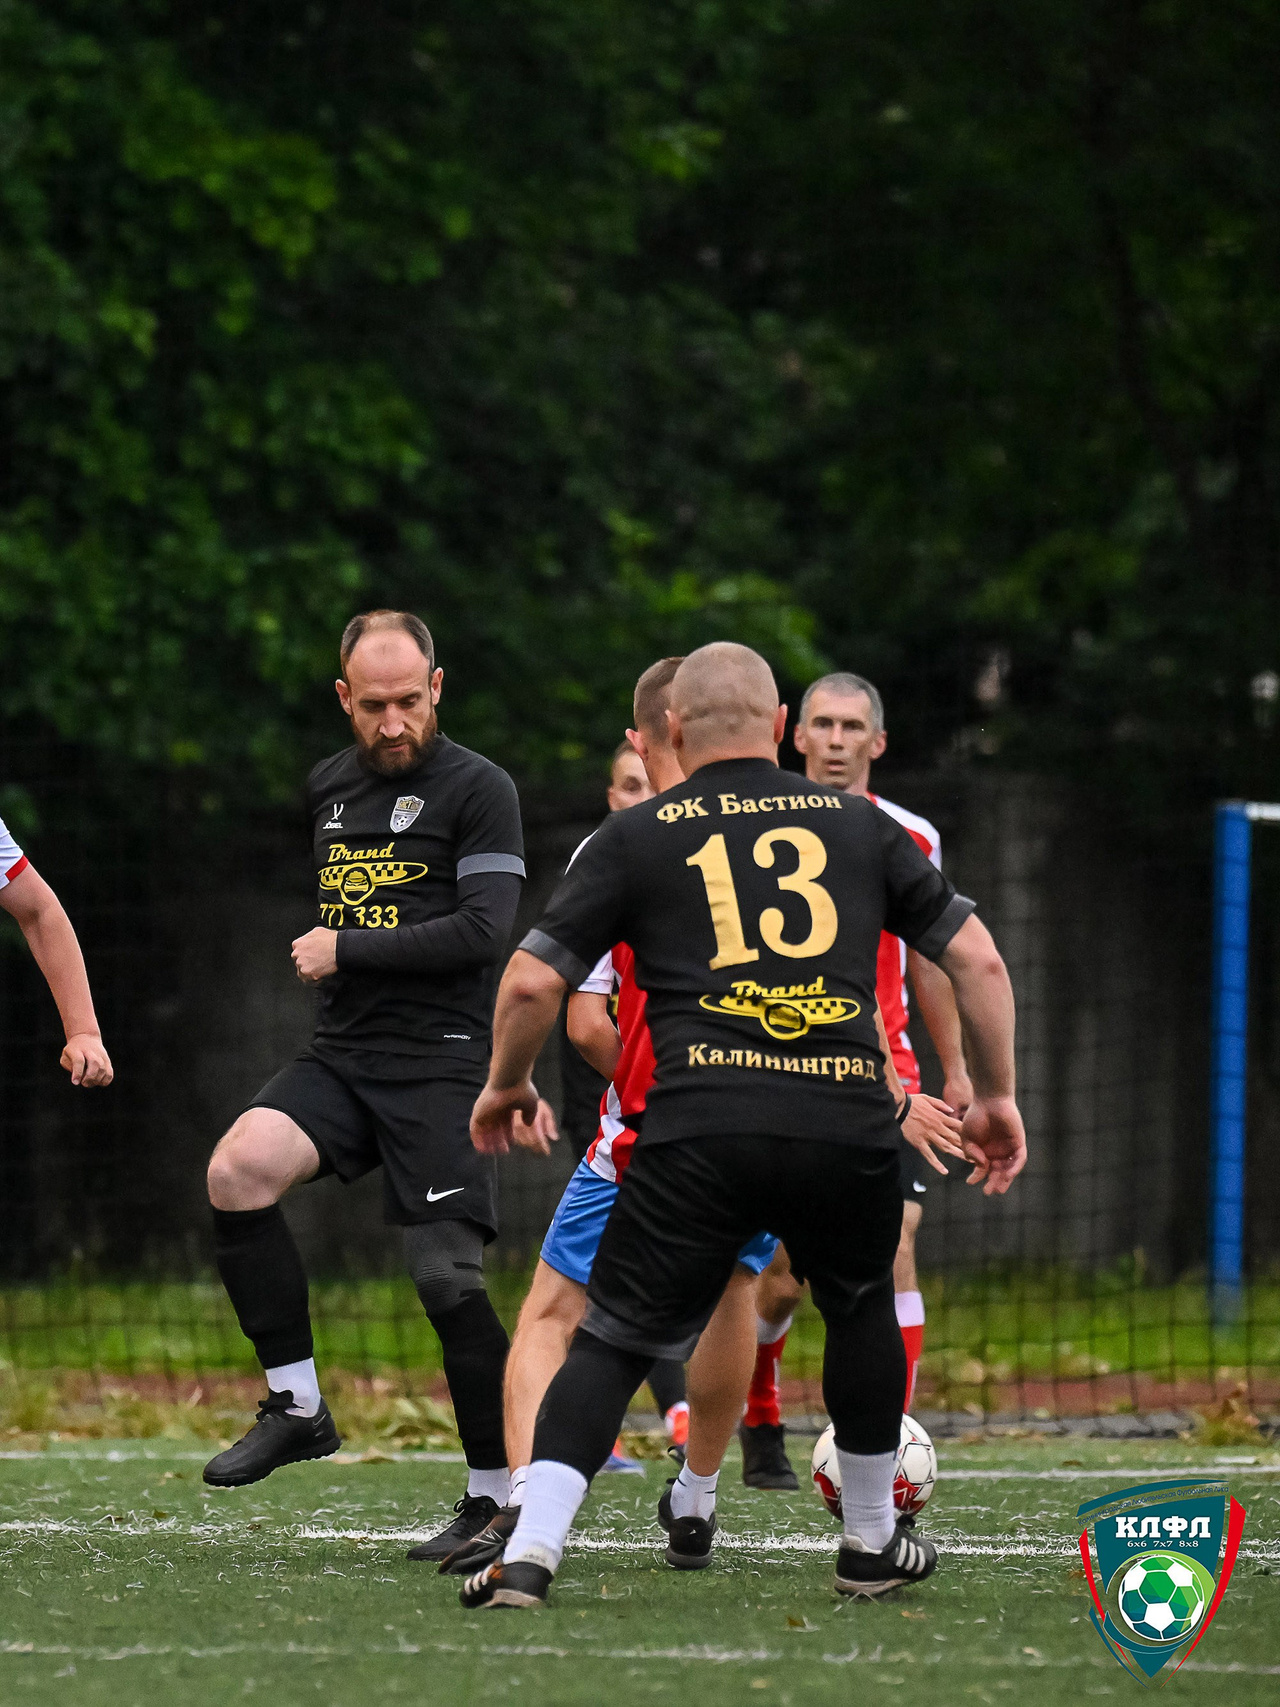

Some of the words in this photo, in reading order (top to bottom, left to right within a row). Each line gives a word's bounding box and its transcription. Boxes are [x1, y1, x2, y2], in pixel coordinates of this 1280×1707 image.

[656, 797, 709, 824] ФК
[717, 793, 843, 815] Бастион
[328, 842, 395, 862] Brand
[685, 826, 838, 971] 13
[352, 905, 399, 929] 333
[731, 976, 827, 999] Brand
[687, 1043, 877, 1081] Калининград
